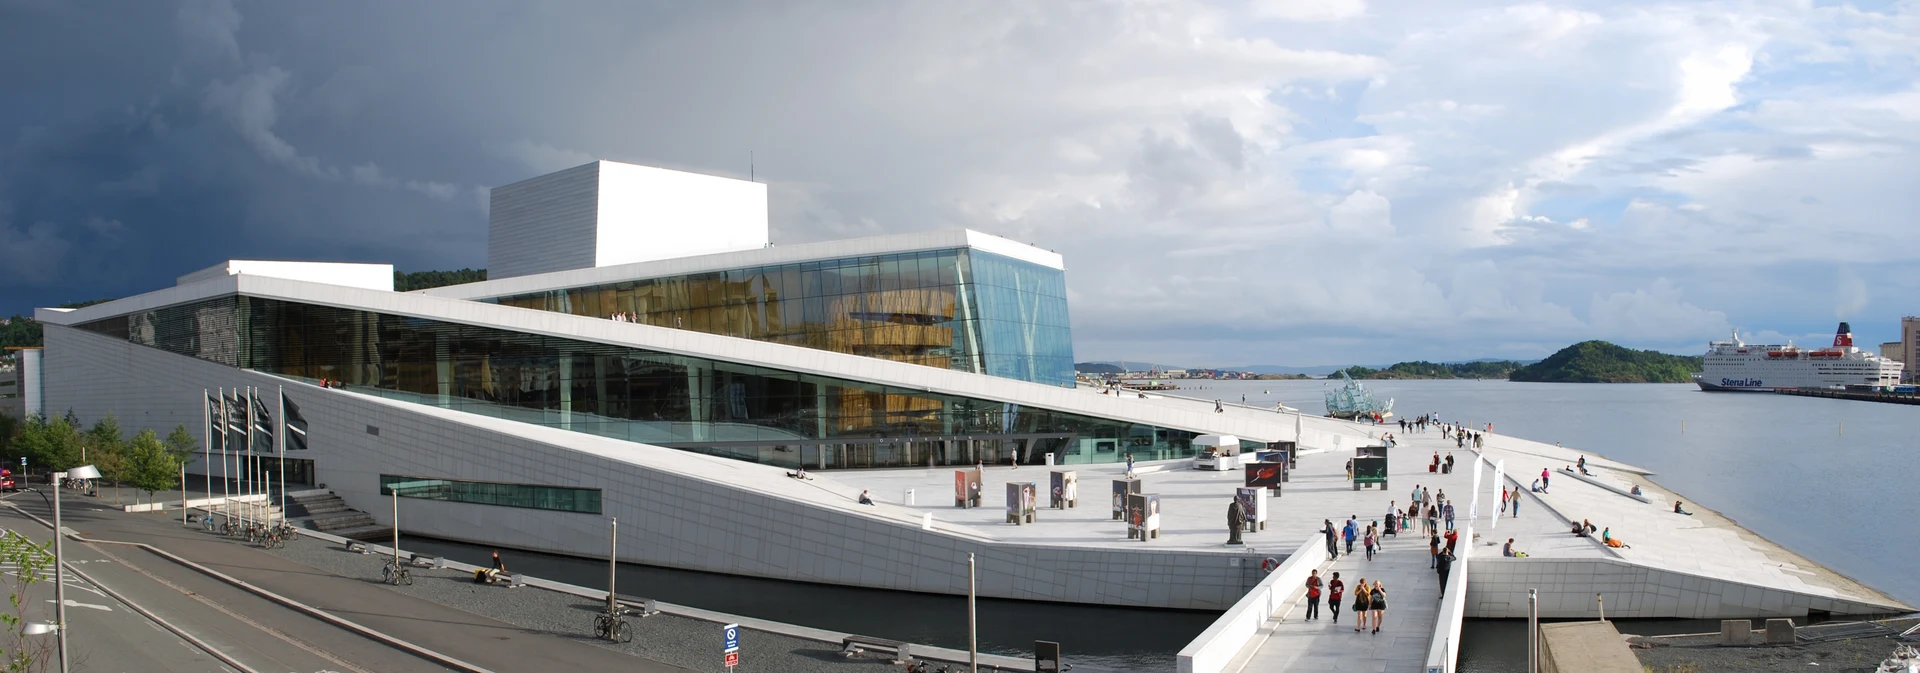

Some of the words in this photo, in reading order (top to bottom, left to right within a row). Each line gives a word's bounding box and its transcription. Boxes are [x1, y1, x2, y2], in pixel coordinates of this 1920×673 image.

[1836, 336, 1842, 345] S
[1721, 377, 1744, 386] Stena
[1745, 377, 1762, 386] Line
